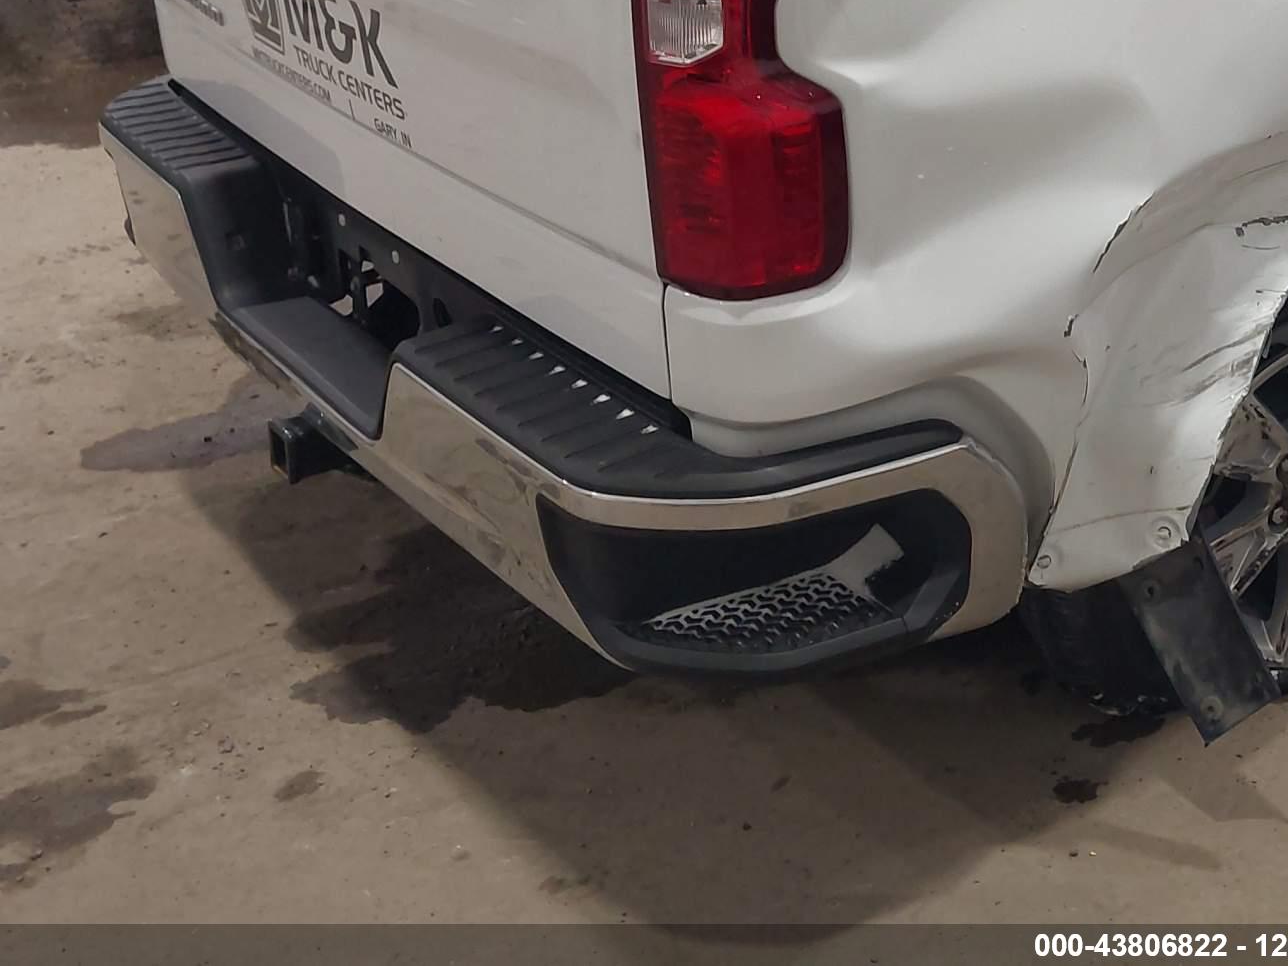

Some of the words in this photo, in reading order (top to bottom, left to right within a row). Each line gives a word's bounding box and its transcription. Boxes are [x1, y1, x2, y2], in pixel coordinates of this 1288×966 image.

[293, 44, 337, 84] TRUCK
[338, 70, 405, 120] CENTERS
[400, 131, 412, 148] IN
